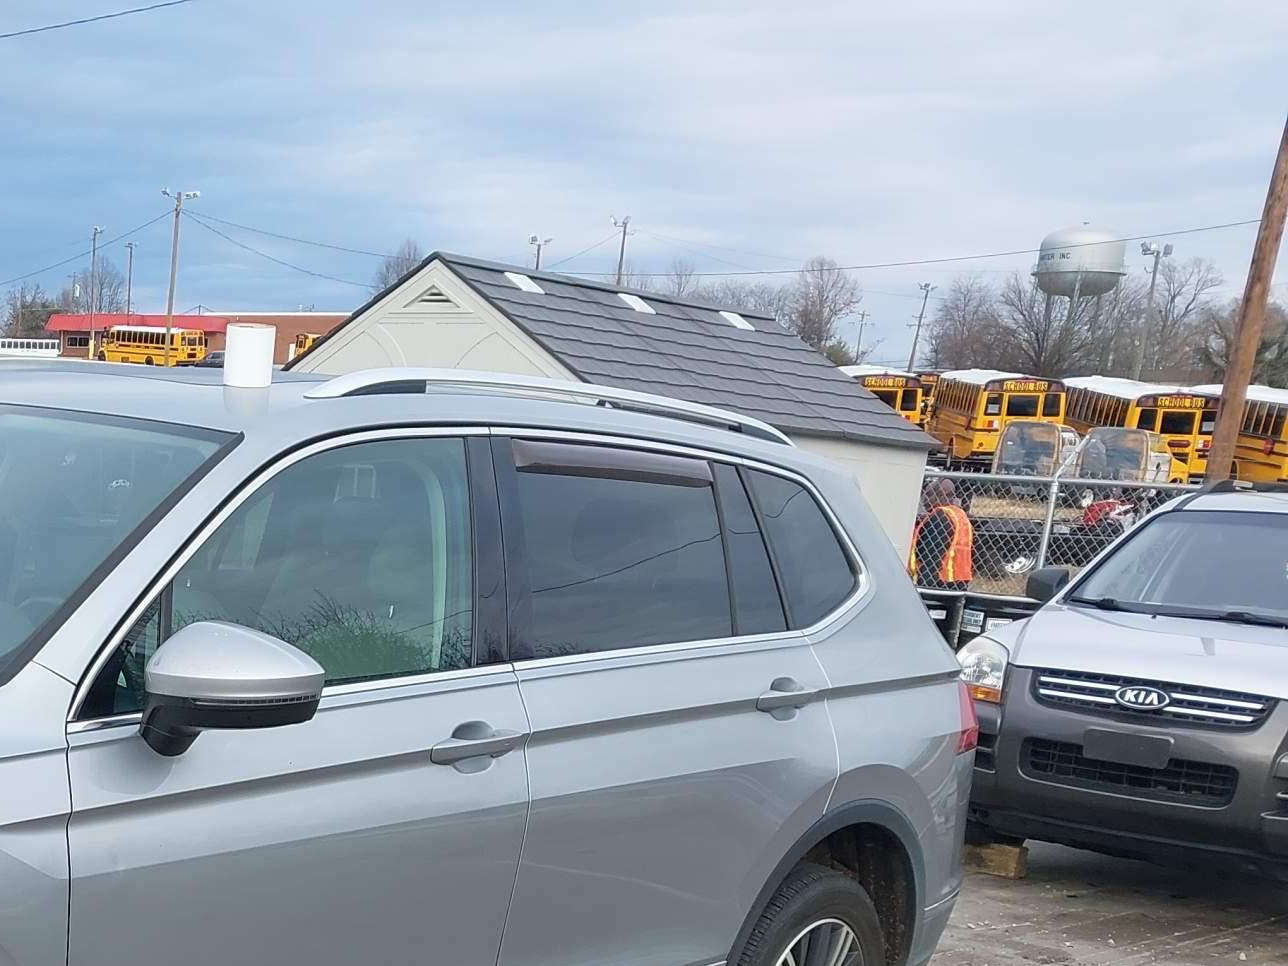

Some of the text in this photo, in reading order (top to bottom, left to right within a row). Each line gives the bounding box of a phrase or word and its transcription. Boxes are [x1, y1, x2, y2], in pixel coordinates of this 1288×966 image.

[865, 377, 892, 387] SCHOOL
[1004, 381, 1048, 391] SCHOOL BUS
[1159, 397, 1205, 408] SCHOOL BUS
[1123, 689, 1159, 705] KIA
